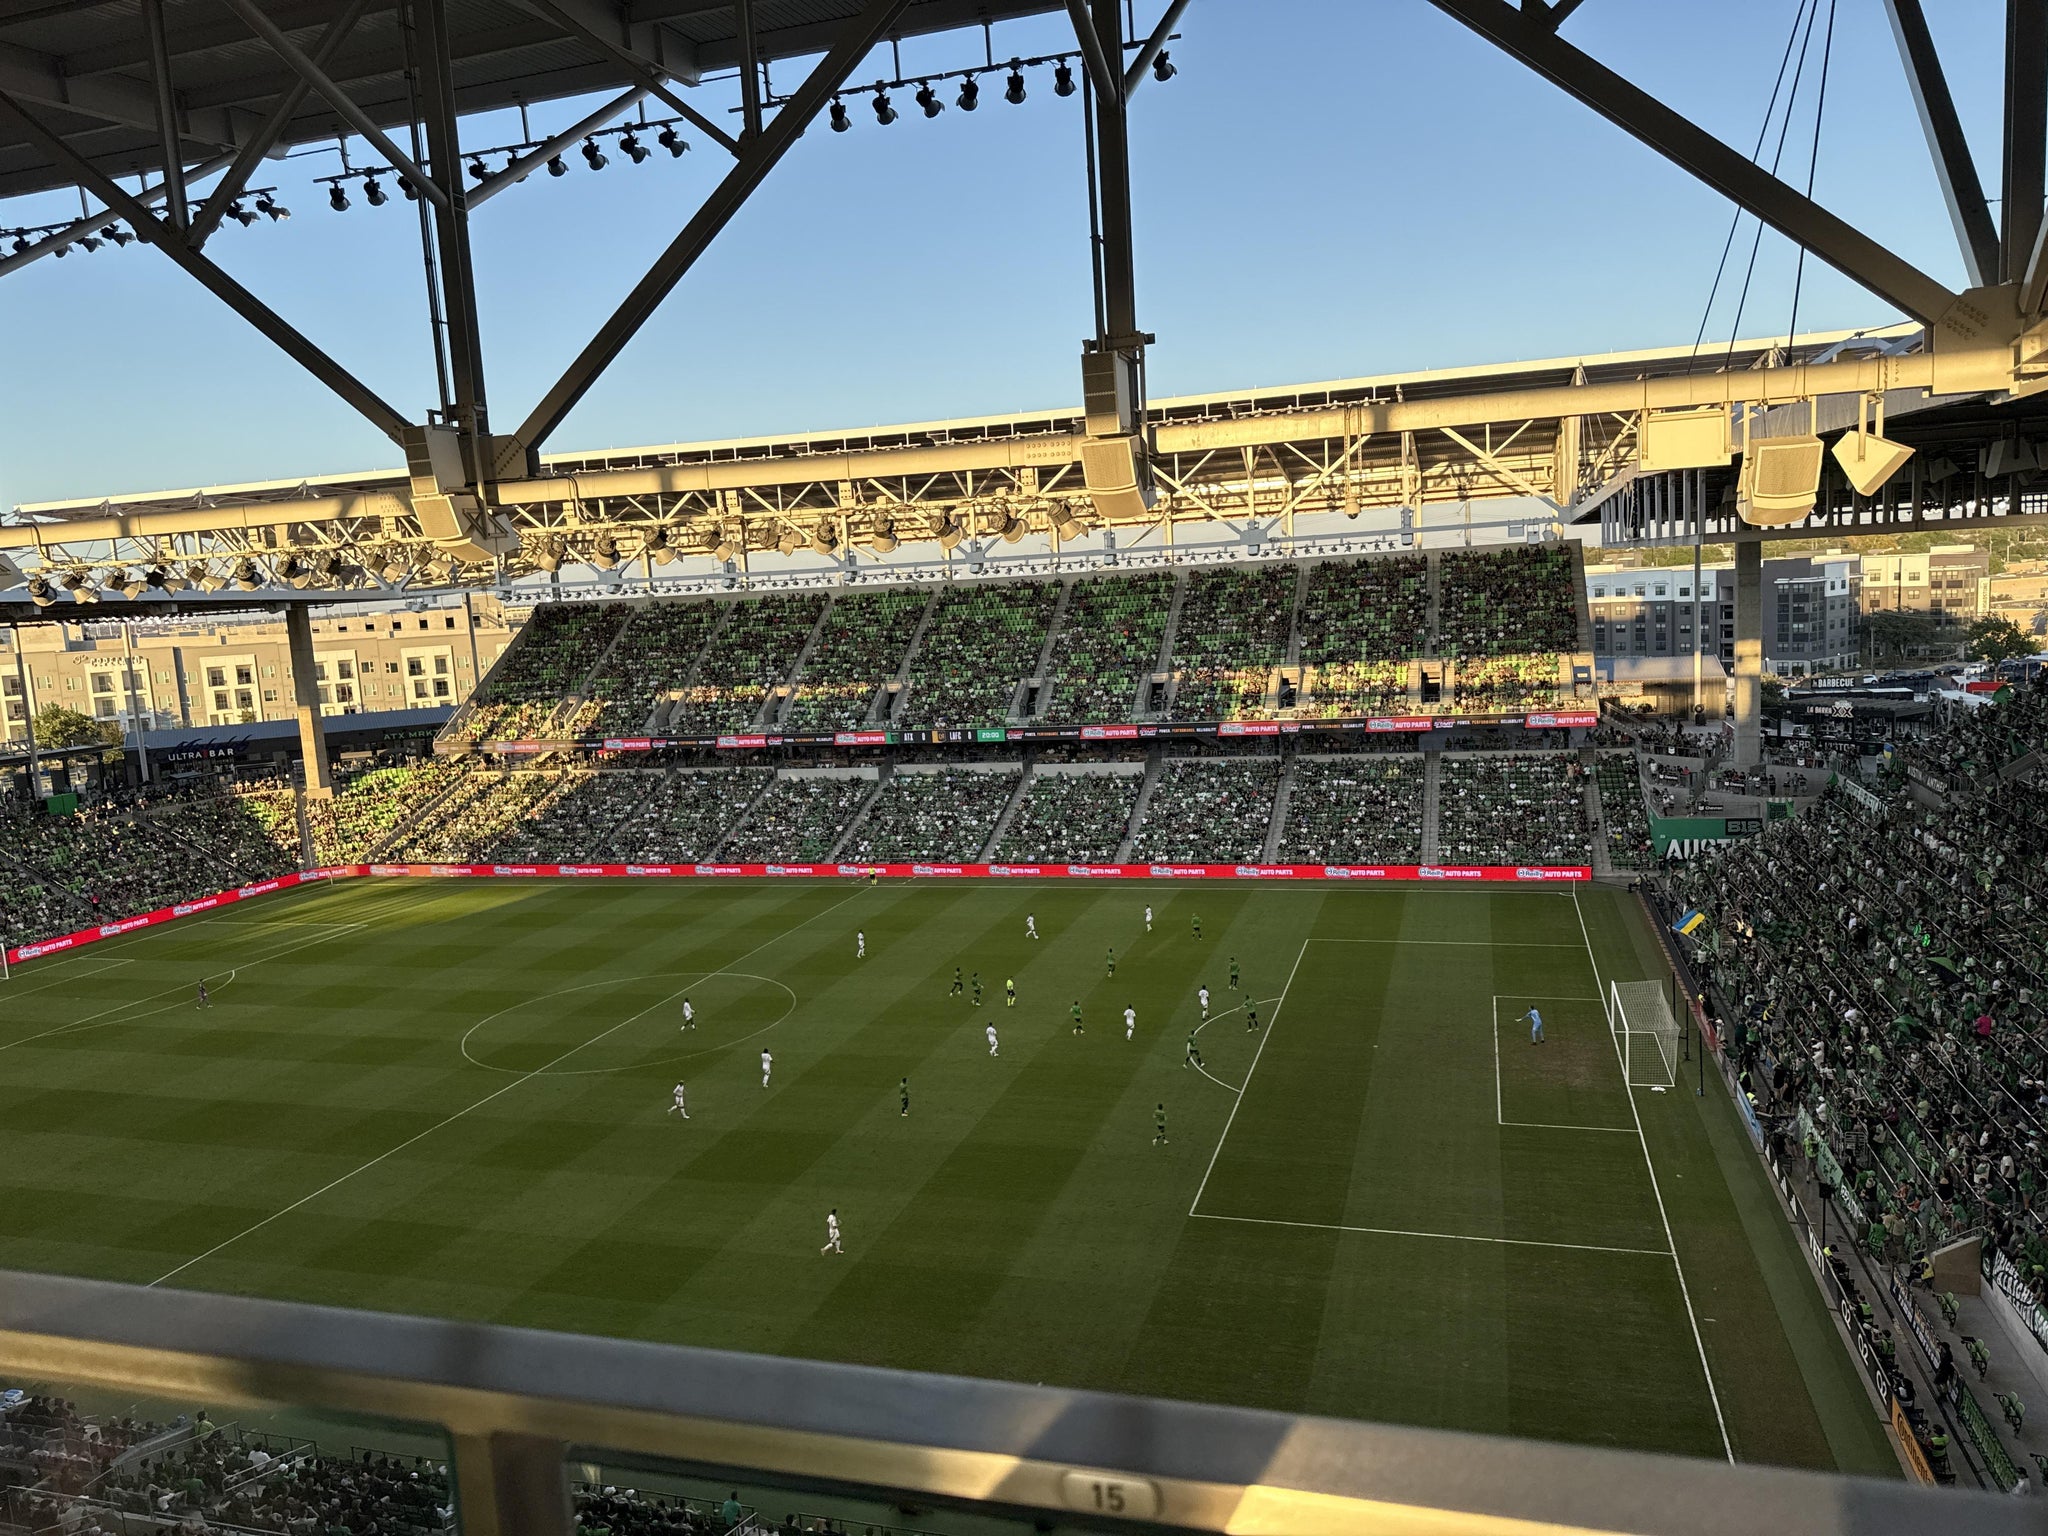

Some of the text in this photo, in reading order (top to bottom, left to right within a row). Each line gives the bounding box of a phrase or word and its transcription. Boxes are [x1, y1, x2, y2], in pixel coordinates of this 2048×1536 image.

[1818, 678, 1854, 687] BARBECUE
[1557, 717, 1574, 725] AUTO
[1574, 716, 1596, 724] PARTS
[904, 732, 914, 741] ATX
[950, 731, 961, 740] LAFC
[168, 748, 234, 761] ULTRA BAR
[1666, 839, 1745, 860] AUST
[192, 902, 203, 911] AUTO
[204, 899, 217, 908] PARTS
[121, 921, 134, 931] AUTO
[134, 918, 148, 927] PARTS
[42, 943, 56, 953] AUTO
[56, 939, 72, 948] PARTS
[1808, 1224, 1825, 1275] YETI
[1897, 1412, 1934, 1484] Continent
[1092, 1482, 1125, 1513] 15
